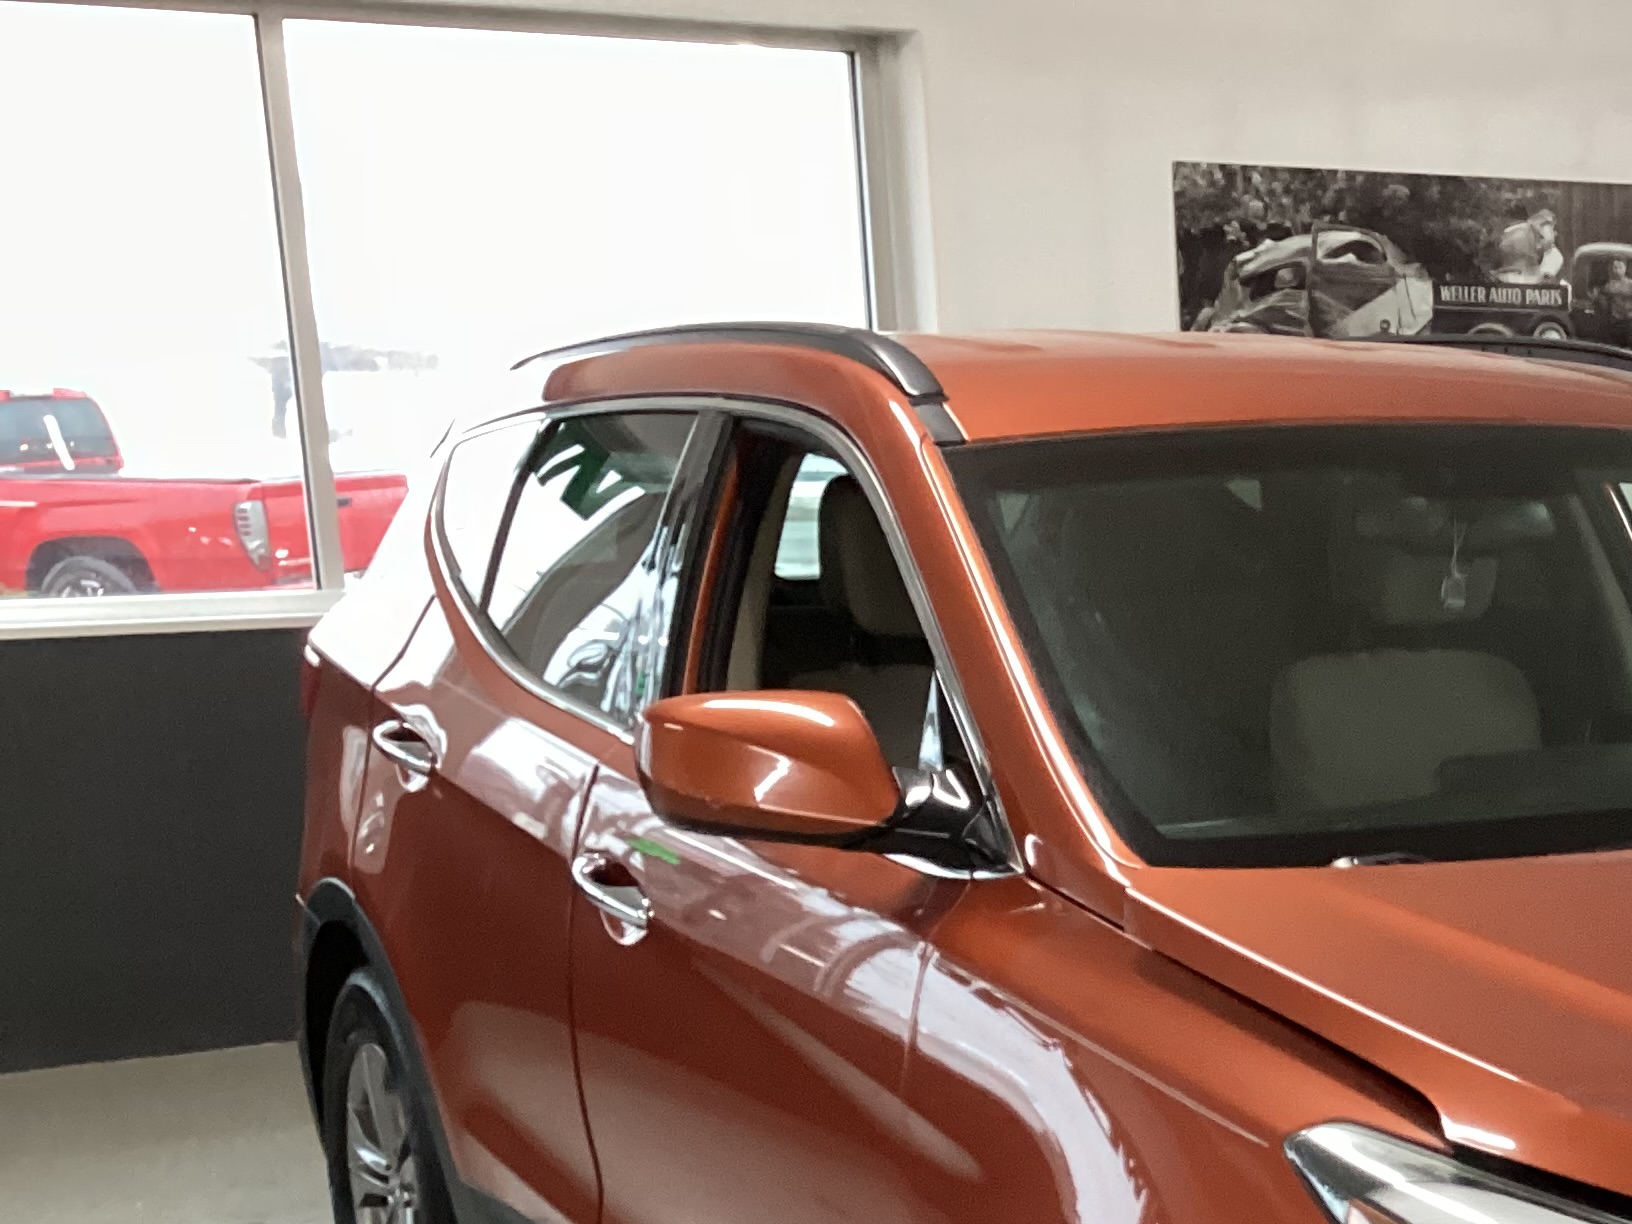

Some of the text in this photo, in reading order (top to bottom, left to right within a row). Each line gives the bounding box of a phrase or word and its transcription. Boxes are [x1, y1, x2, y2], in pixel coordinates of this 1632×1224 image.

[1440, 285, 1562, 306] WELLER AUTO PARTS
